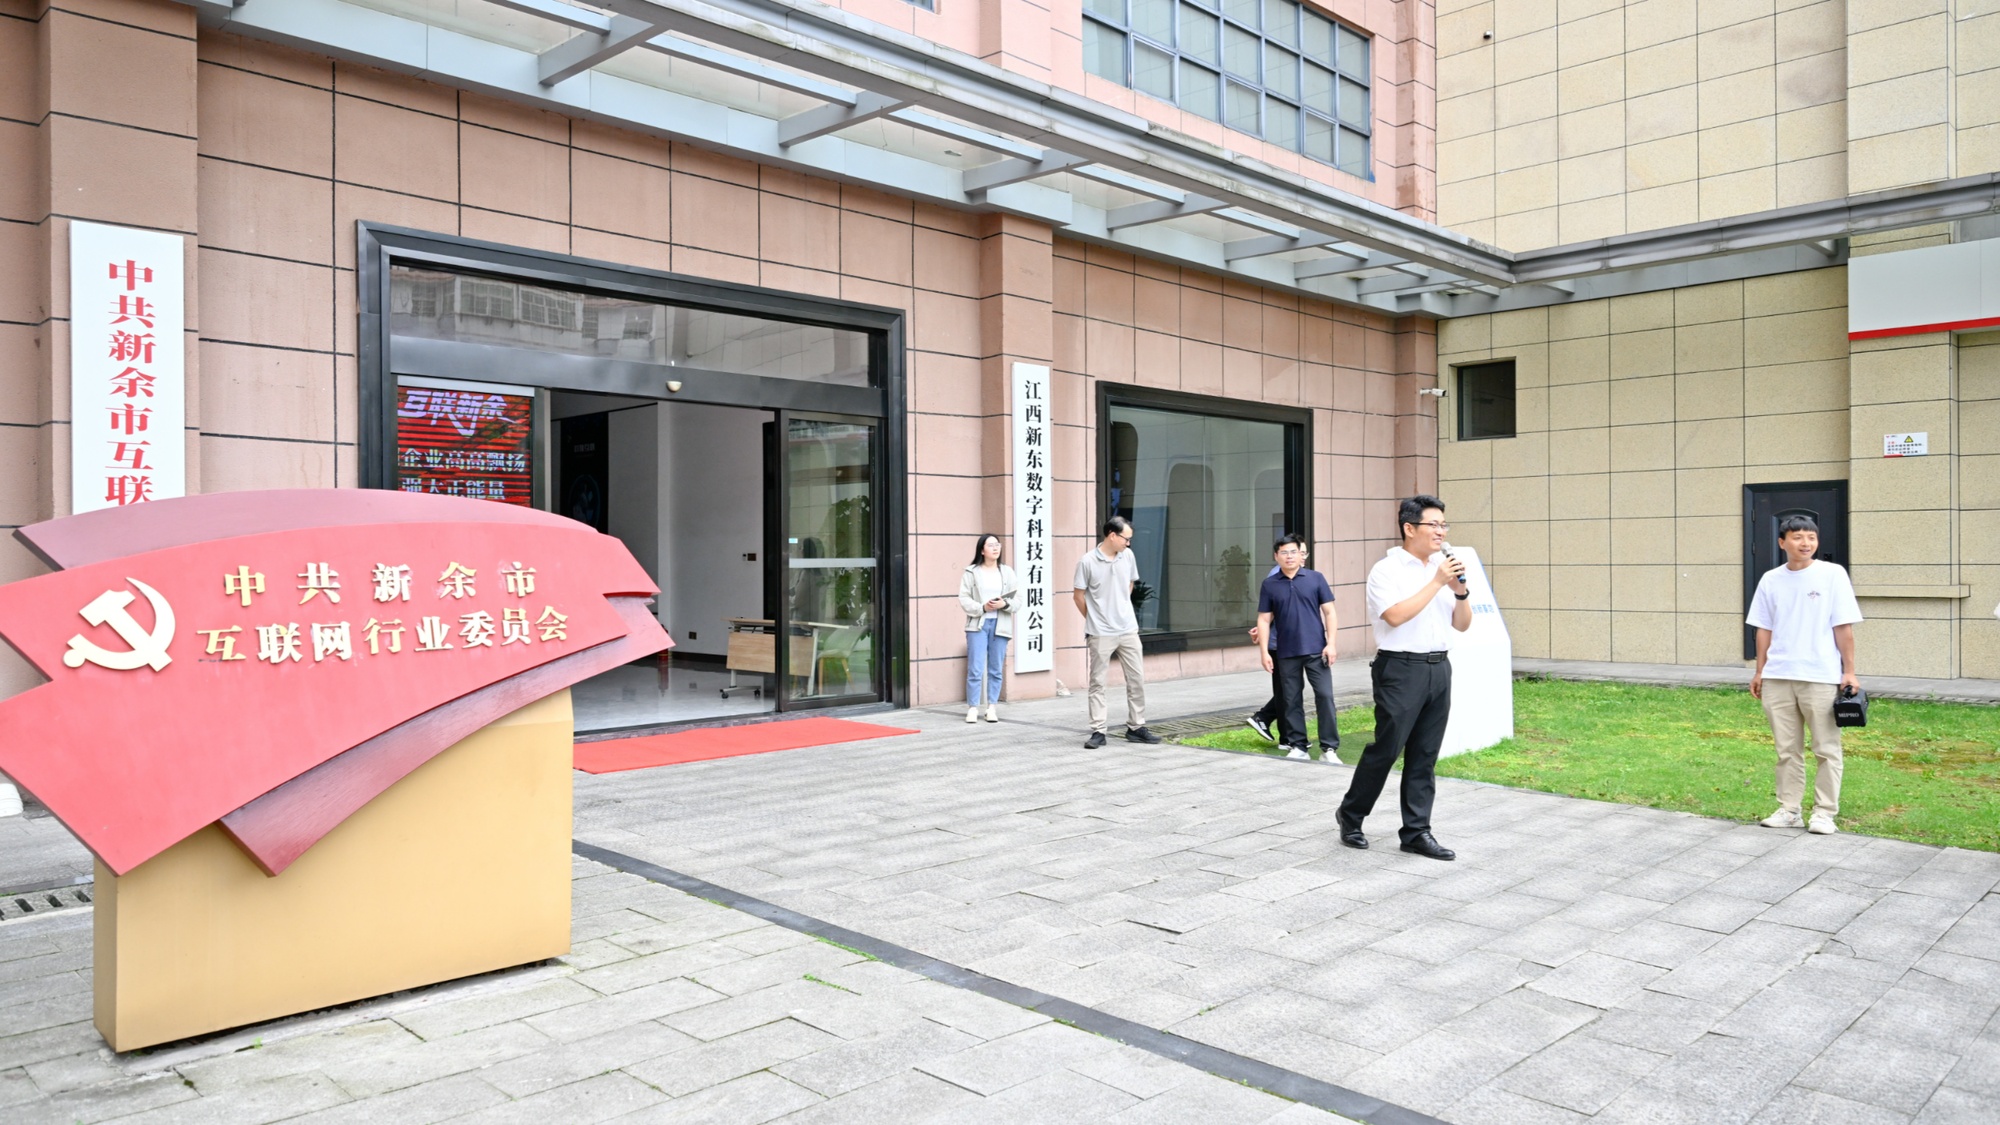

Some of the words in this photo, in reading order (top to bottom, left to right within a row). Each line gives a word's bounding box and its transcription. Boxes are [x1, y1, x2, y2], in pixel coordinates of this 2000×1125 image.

[104, 259, 158, 506] 中共新余市互联
[223, 561, 537, 606] 中共新余市
[1024, 380, 1044, 653] 江西新东数字科技有限公司
[196, 605, 568, 664] 互联网行业委员会
